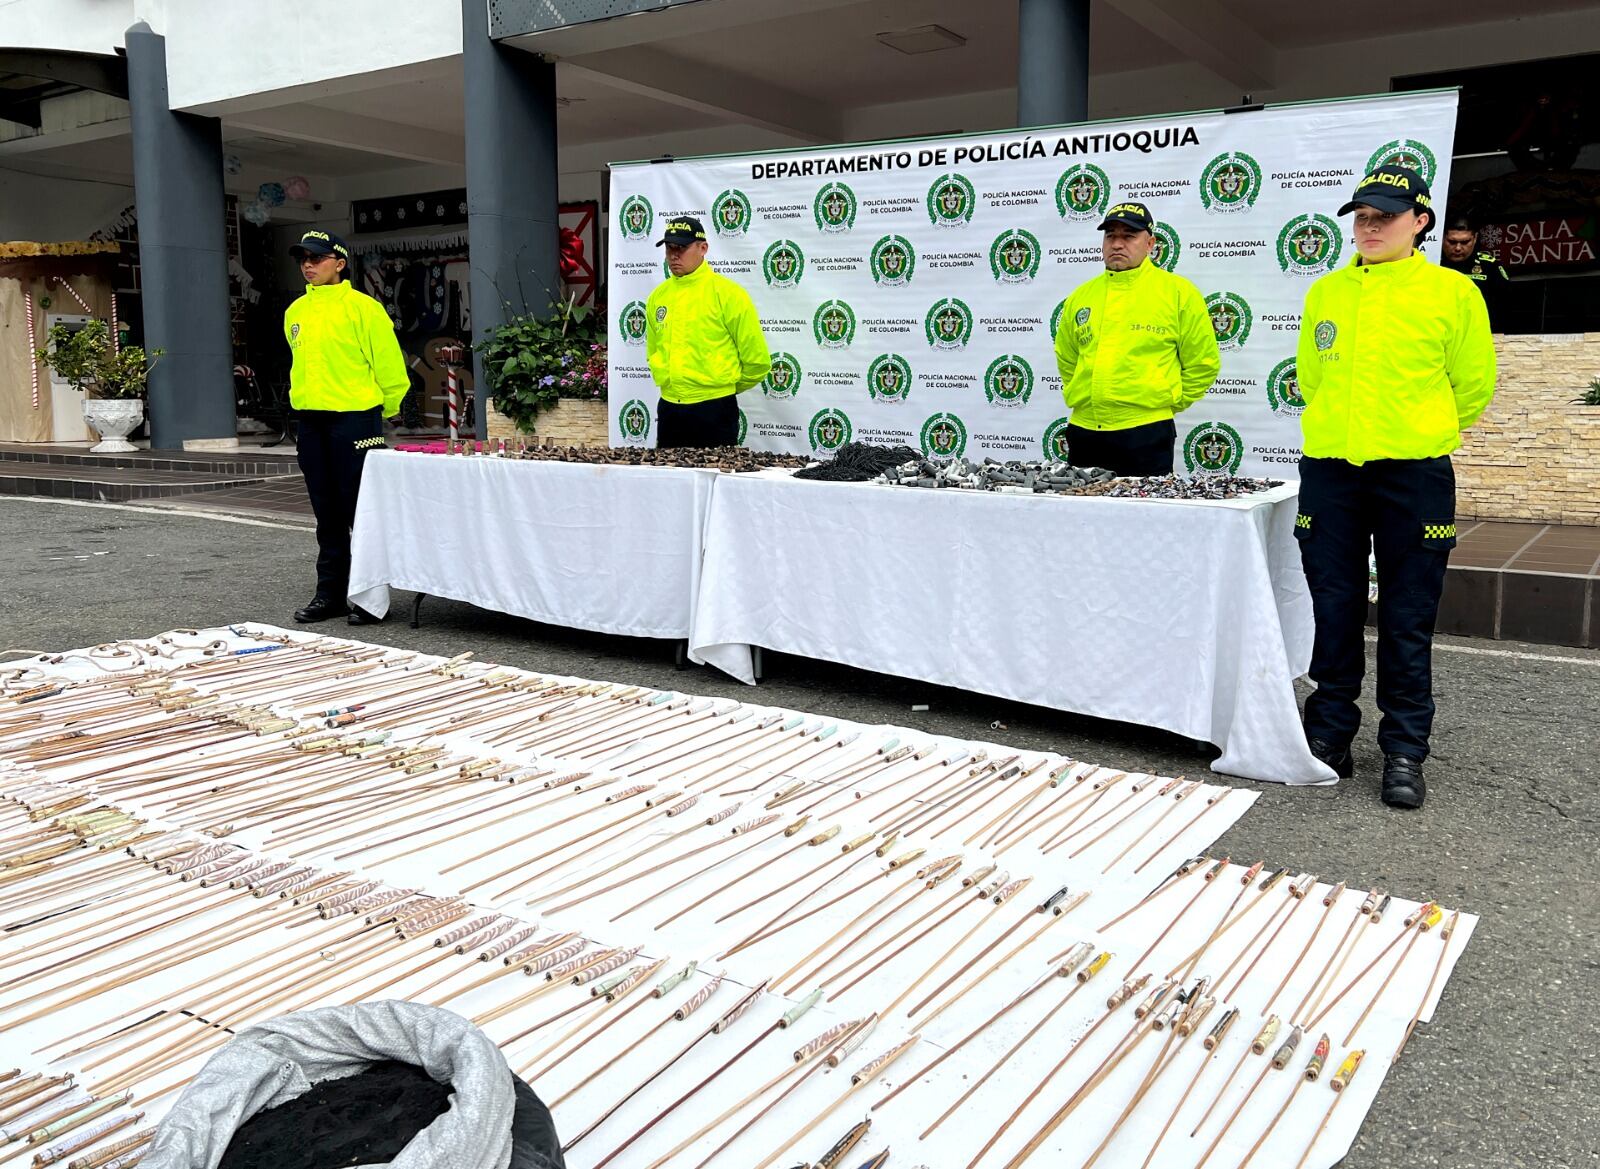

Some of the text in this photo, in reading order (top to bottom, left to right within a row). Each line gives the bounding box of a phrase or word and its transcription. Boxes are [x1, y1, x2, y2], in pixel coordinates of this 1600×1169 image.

[752, 126, 1199, 180] DEPARTAMENTO DE POLICÍA ANTIOQUIA
[1272, 169, 1354, 180] POLICÍA NACIONAL
[1119, 180, 1191, 190] POLICÍA NACIONAL
[1295, 179, 1342, 188] COLOMBIA
[1140, 189, 1181, 197] COLOMBIA
[1002, 198, 1038, 206] COLOMBIA
[1505, 219, 1575, 244] SALA
[1190, 240, 1266, 249] POLICÍA NACIONAL
[1079, 247, 1104, 256] NACIO
[1510, 241, 1597, 265] SANTA
